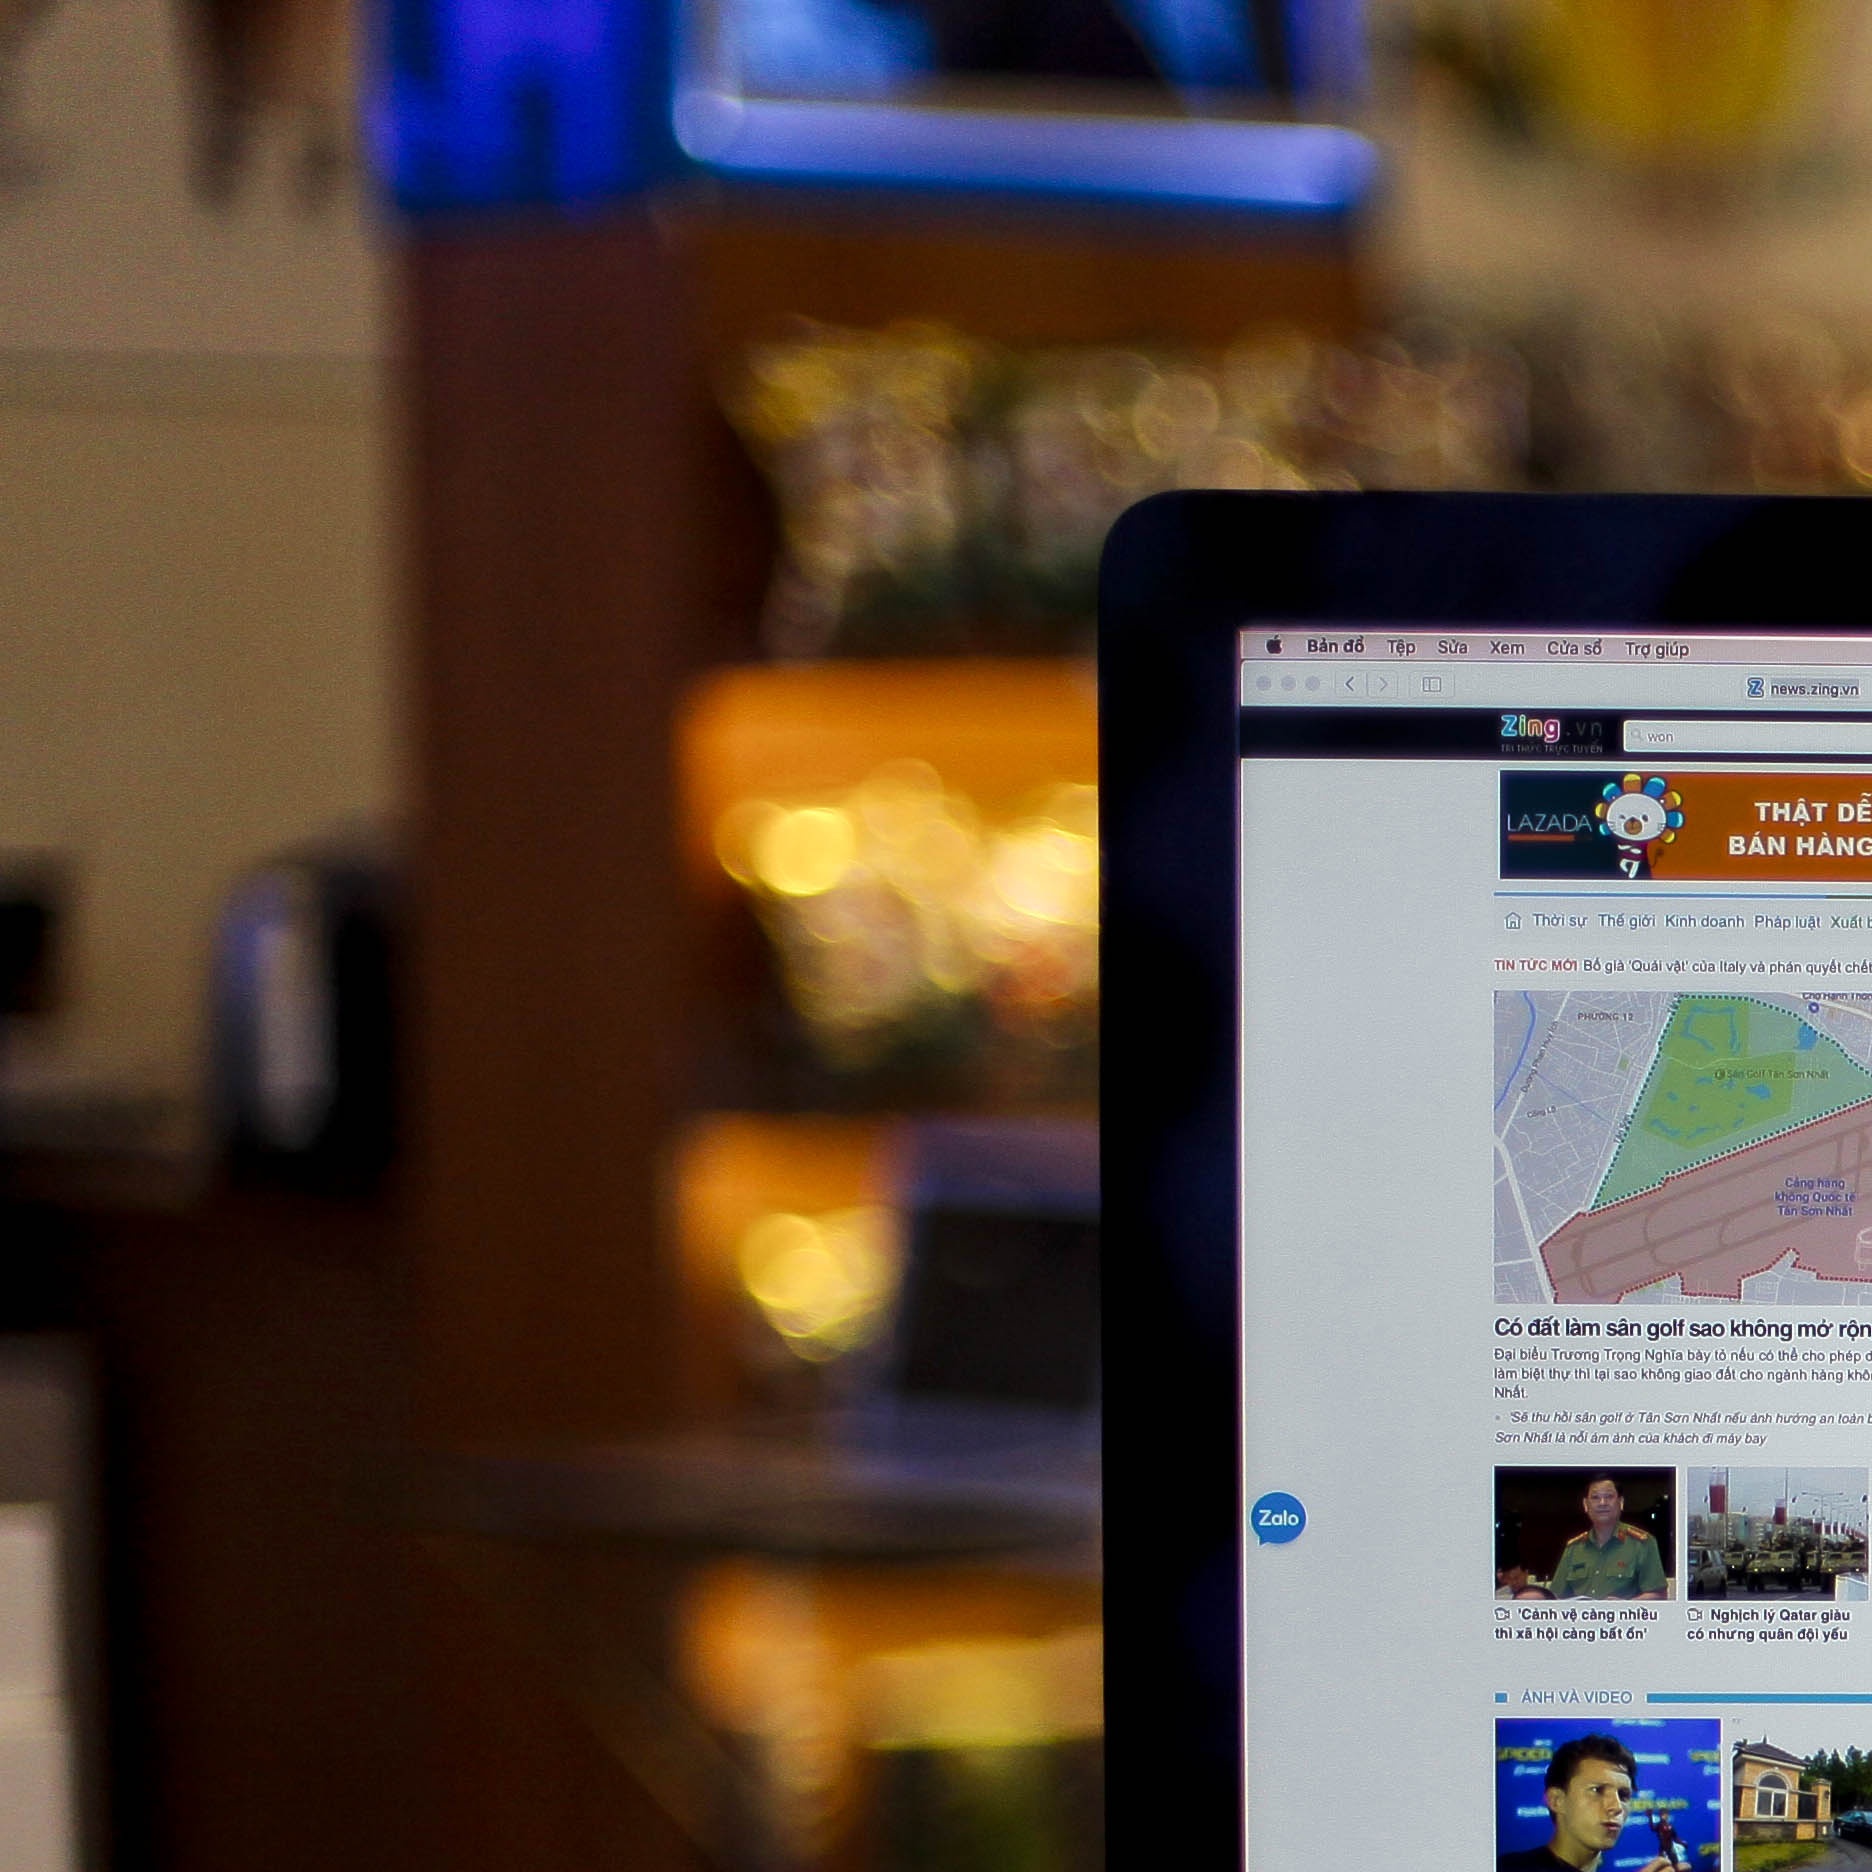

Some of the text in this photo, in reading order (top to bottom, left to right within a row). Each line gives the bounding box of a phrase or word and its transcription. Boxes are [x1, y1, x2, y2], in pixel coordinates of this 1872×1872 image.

[1308, 637, 1338, 652] Bản
[1344, 635, 1364, 653] đồ
[1387, 639, 1415, 656] Tệp
[1439, 639, 1467, 654] Sửa
[1491, 641, 1524, 654] Xem
[1626, 642, 1650, 659] Trợ
[1656, 641, 1688, 659] giúp
[1771, 682, 1858, 698] news.zing.vn
[1754, 798, 1828, 826] THẬT
[1838, 793, 1872, 822] DỄ
[1507, 813, 1592, 833] LAZADA
[1729, 831, 1785, 855] BÁN
[1495, 1317, 1522, 1336] Có
[1528, 1316, 1560, 1336] đất
[1566, 1318, 1600, 1336] làm
[1606, 1318, 1641, 1336] sân
[1647, 1319, 1684, 1341] golf
[1690, 1323, 1725, 1336] sao
[1731, 1319, 1792, 1342] không
[1798, 1320, 1833, 1338] mở
[1259, 1510, 1299, 1525] Zalo
